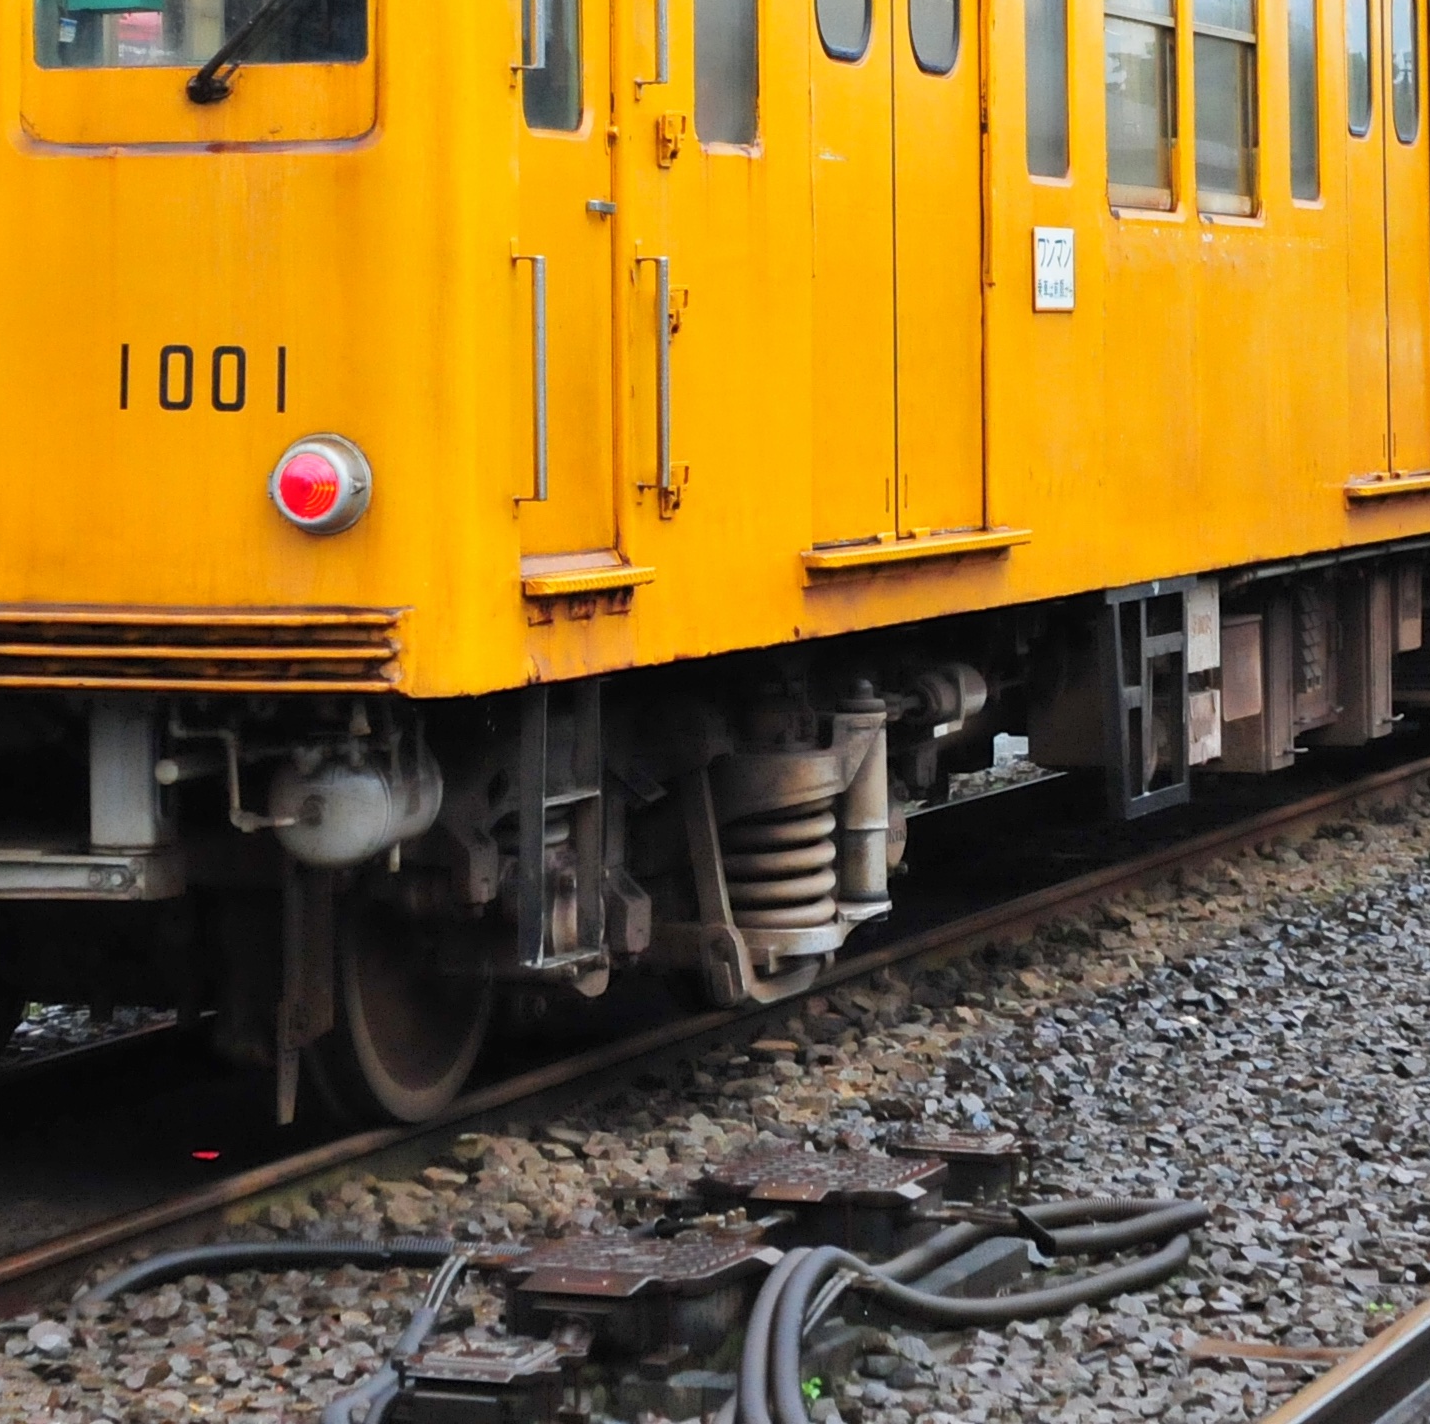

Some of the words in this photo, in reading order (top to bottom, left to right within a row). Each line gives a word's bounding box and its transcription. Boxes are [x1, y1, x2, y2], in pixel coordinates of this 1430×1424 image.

[1037, 238, 1072, 268] ワンマン
[119, 343, 286, 413] 1001
